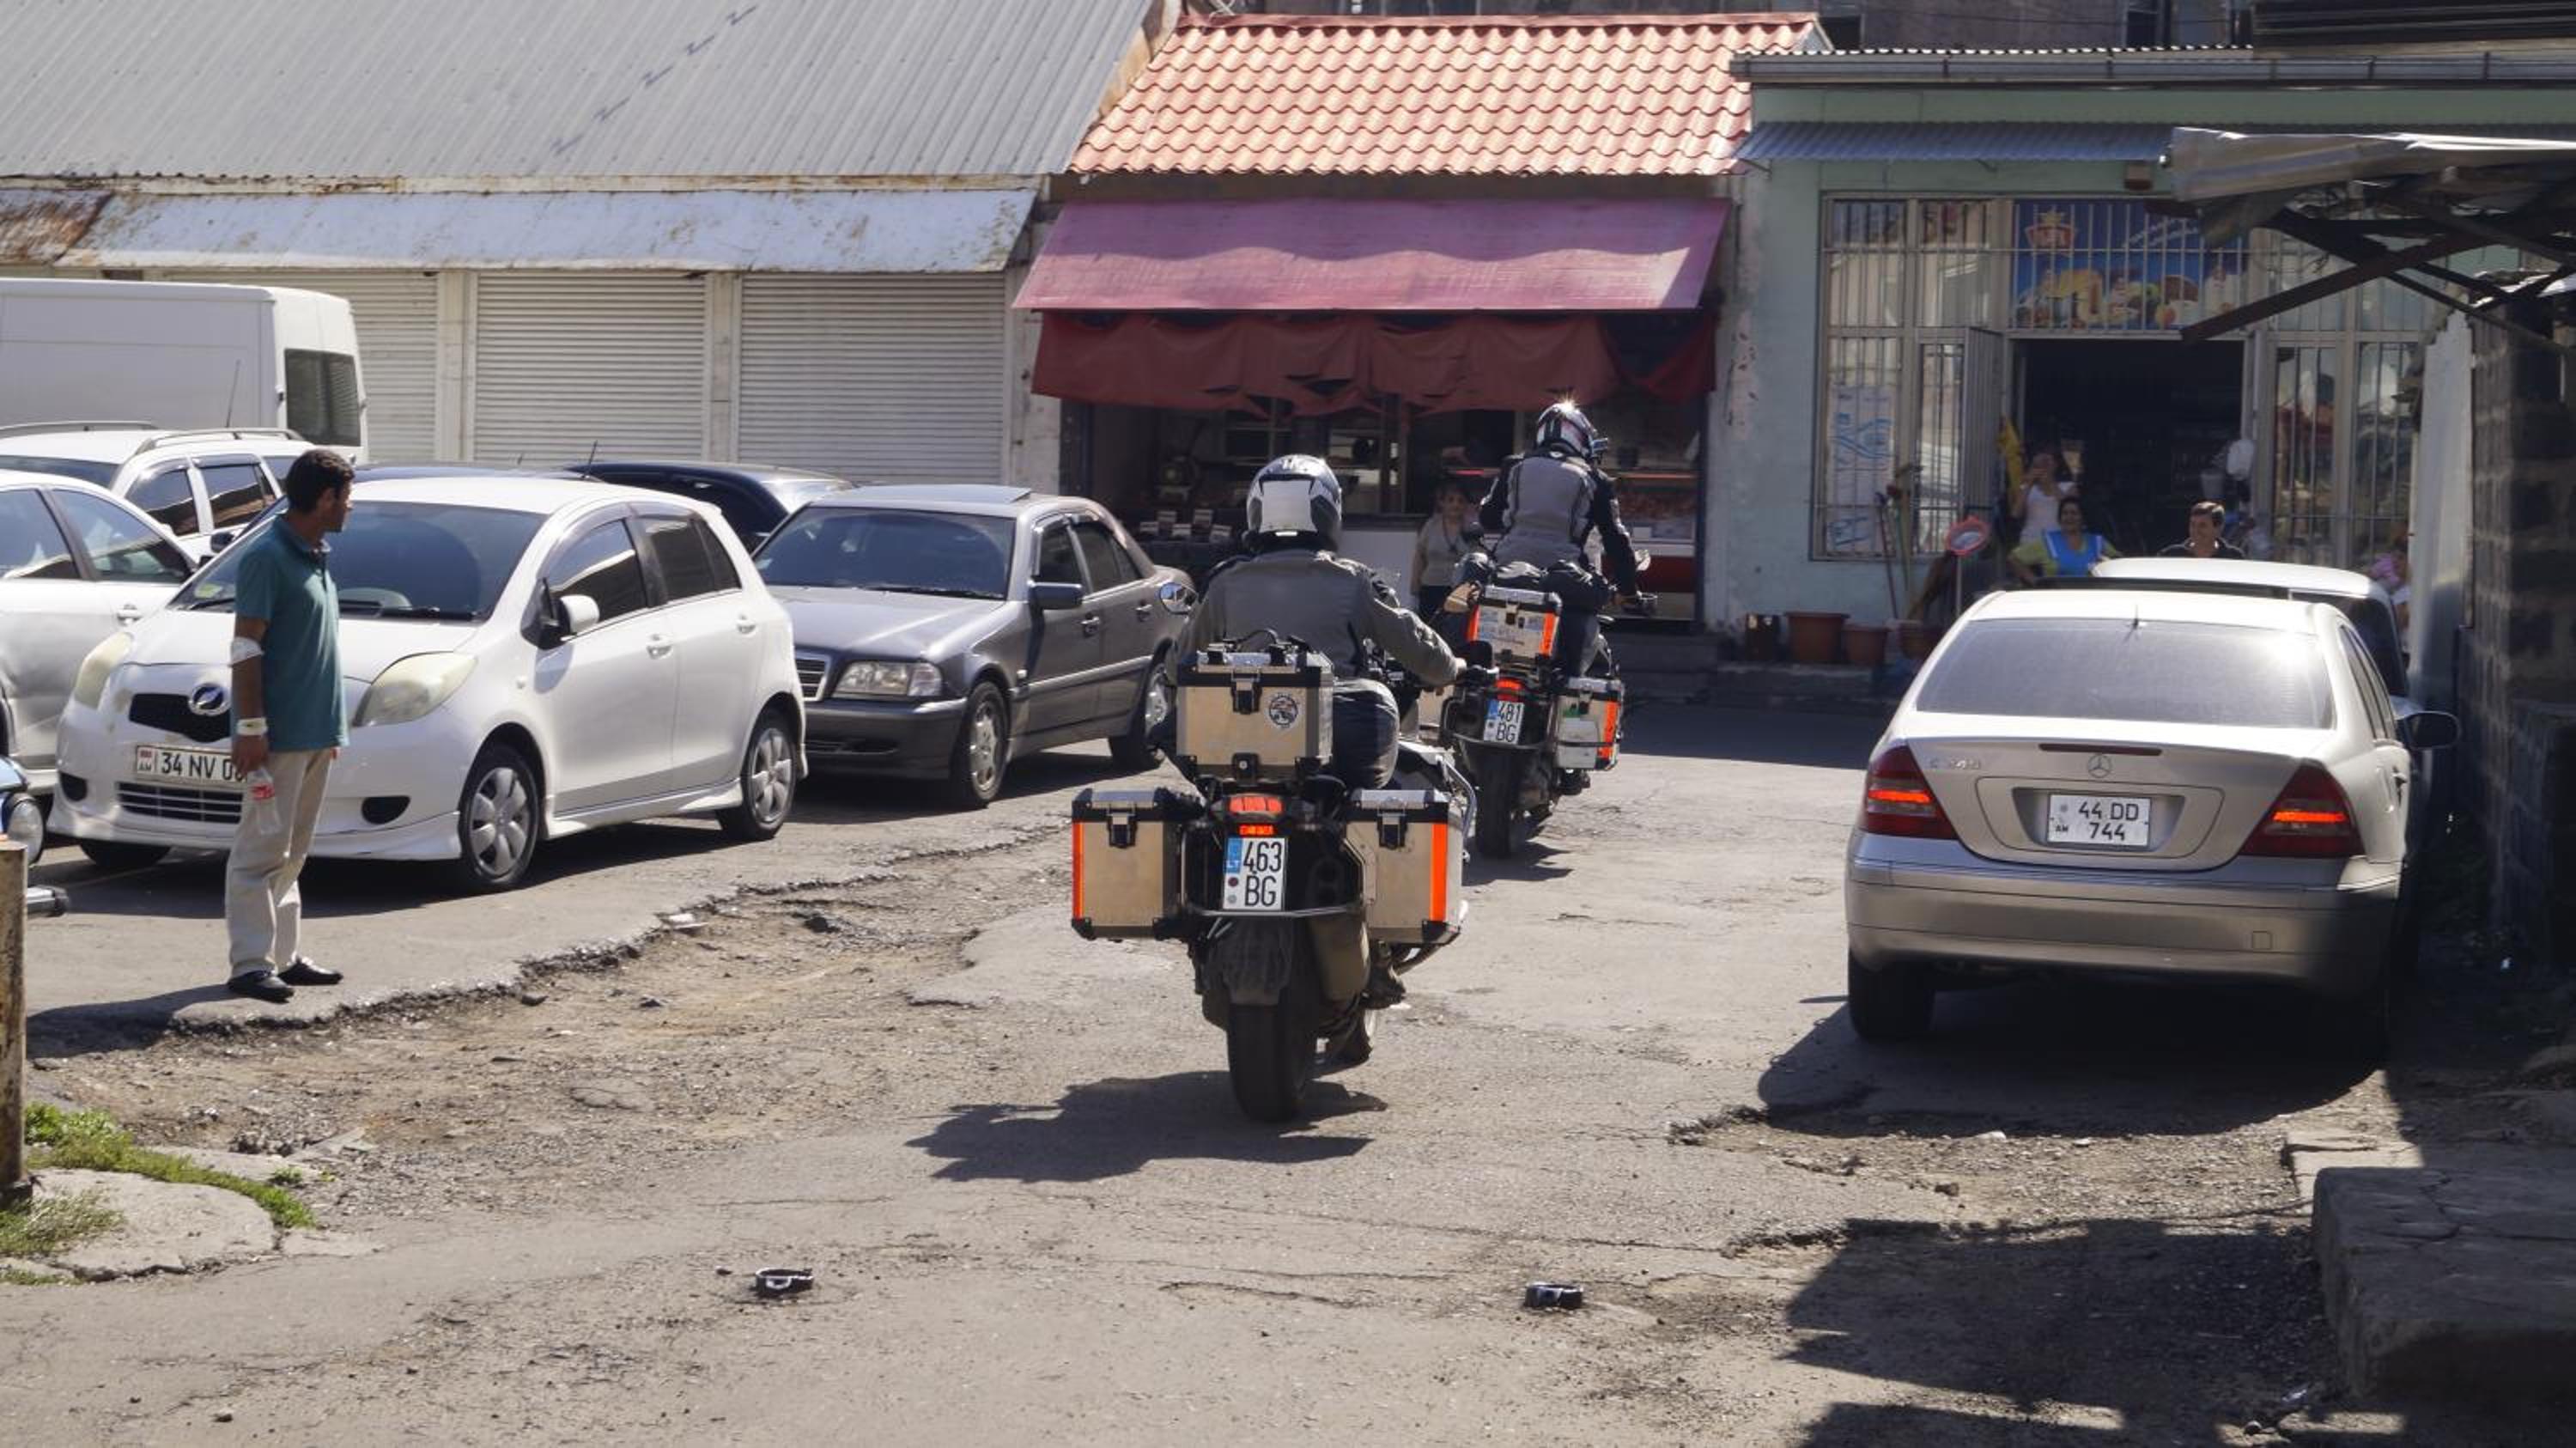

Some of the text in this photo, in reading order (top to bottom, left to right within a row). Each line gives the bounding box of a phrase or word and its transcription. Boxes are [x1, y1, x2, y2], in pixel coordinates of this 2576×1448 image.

[1498, 703, 1521, 723] 481
[1496, 721, 1516, 743] BG
[161, 751, 182, 775] 34
[189, 755, 216, 778] NV
[2078, 801, 2139, 821] 44 DD
[2089, 822, 2125, 841] 744
[1226, 860, 1241, 868] LT
[1242, 841, 1282, 873] 463
[1244, 874, 1277, 907] BG
